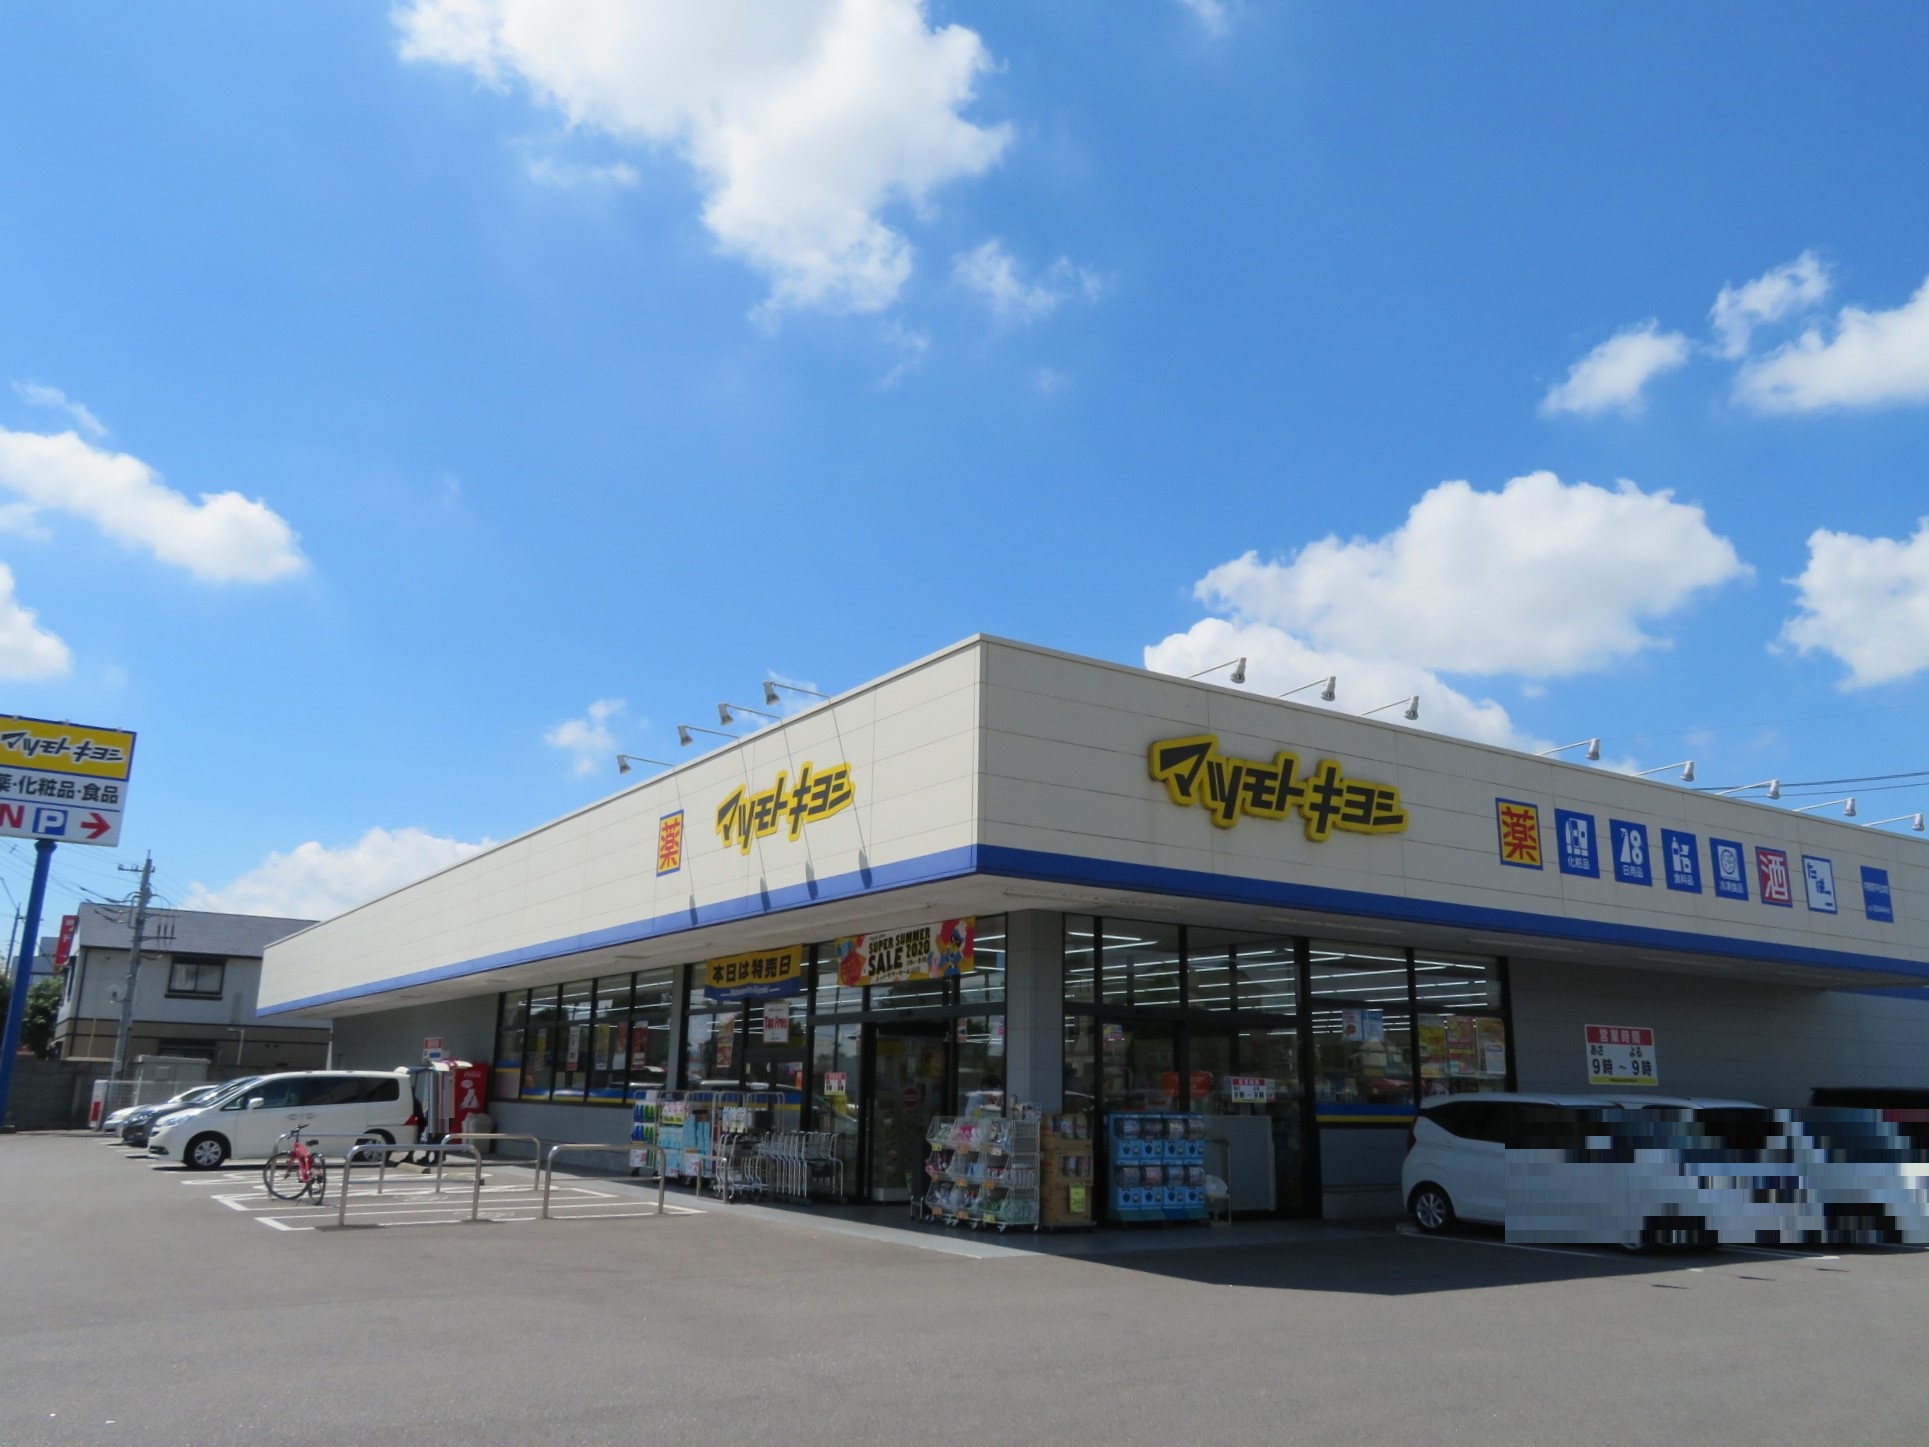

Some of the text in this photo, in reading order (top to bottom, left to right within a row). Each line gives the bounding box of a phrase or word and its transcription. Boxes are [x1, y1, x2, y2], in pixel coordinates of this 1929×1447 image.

[1, 731, 123, 762] マツモトキヨシ
[1158, 740, 1405, 834] マツモトキヨシ
[717, 765, 853, 850] マツモトキヨシ
[660, 817, 681, 870] 薬
[1501, 805, 1538, 863] 薬
[1567, 855, 1591, 871] 化粧品
[1622, 865, 1644, 879] 日用品
[1760, 854, 1789, 900] 酒
[868, 936, 894, 955] SUPER
[895, 926, 931, 947] SUMMER
[712, 954, 792, 984] 本日は特売日
[868, 945, 904, 977] SALE
[906, 939, 931, 959] 2020
[1590, 1044, 1642, 1058] あさ よる
